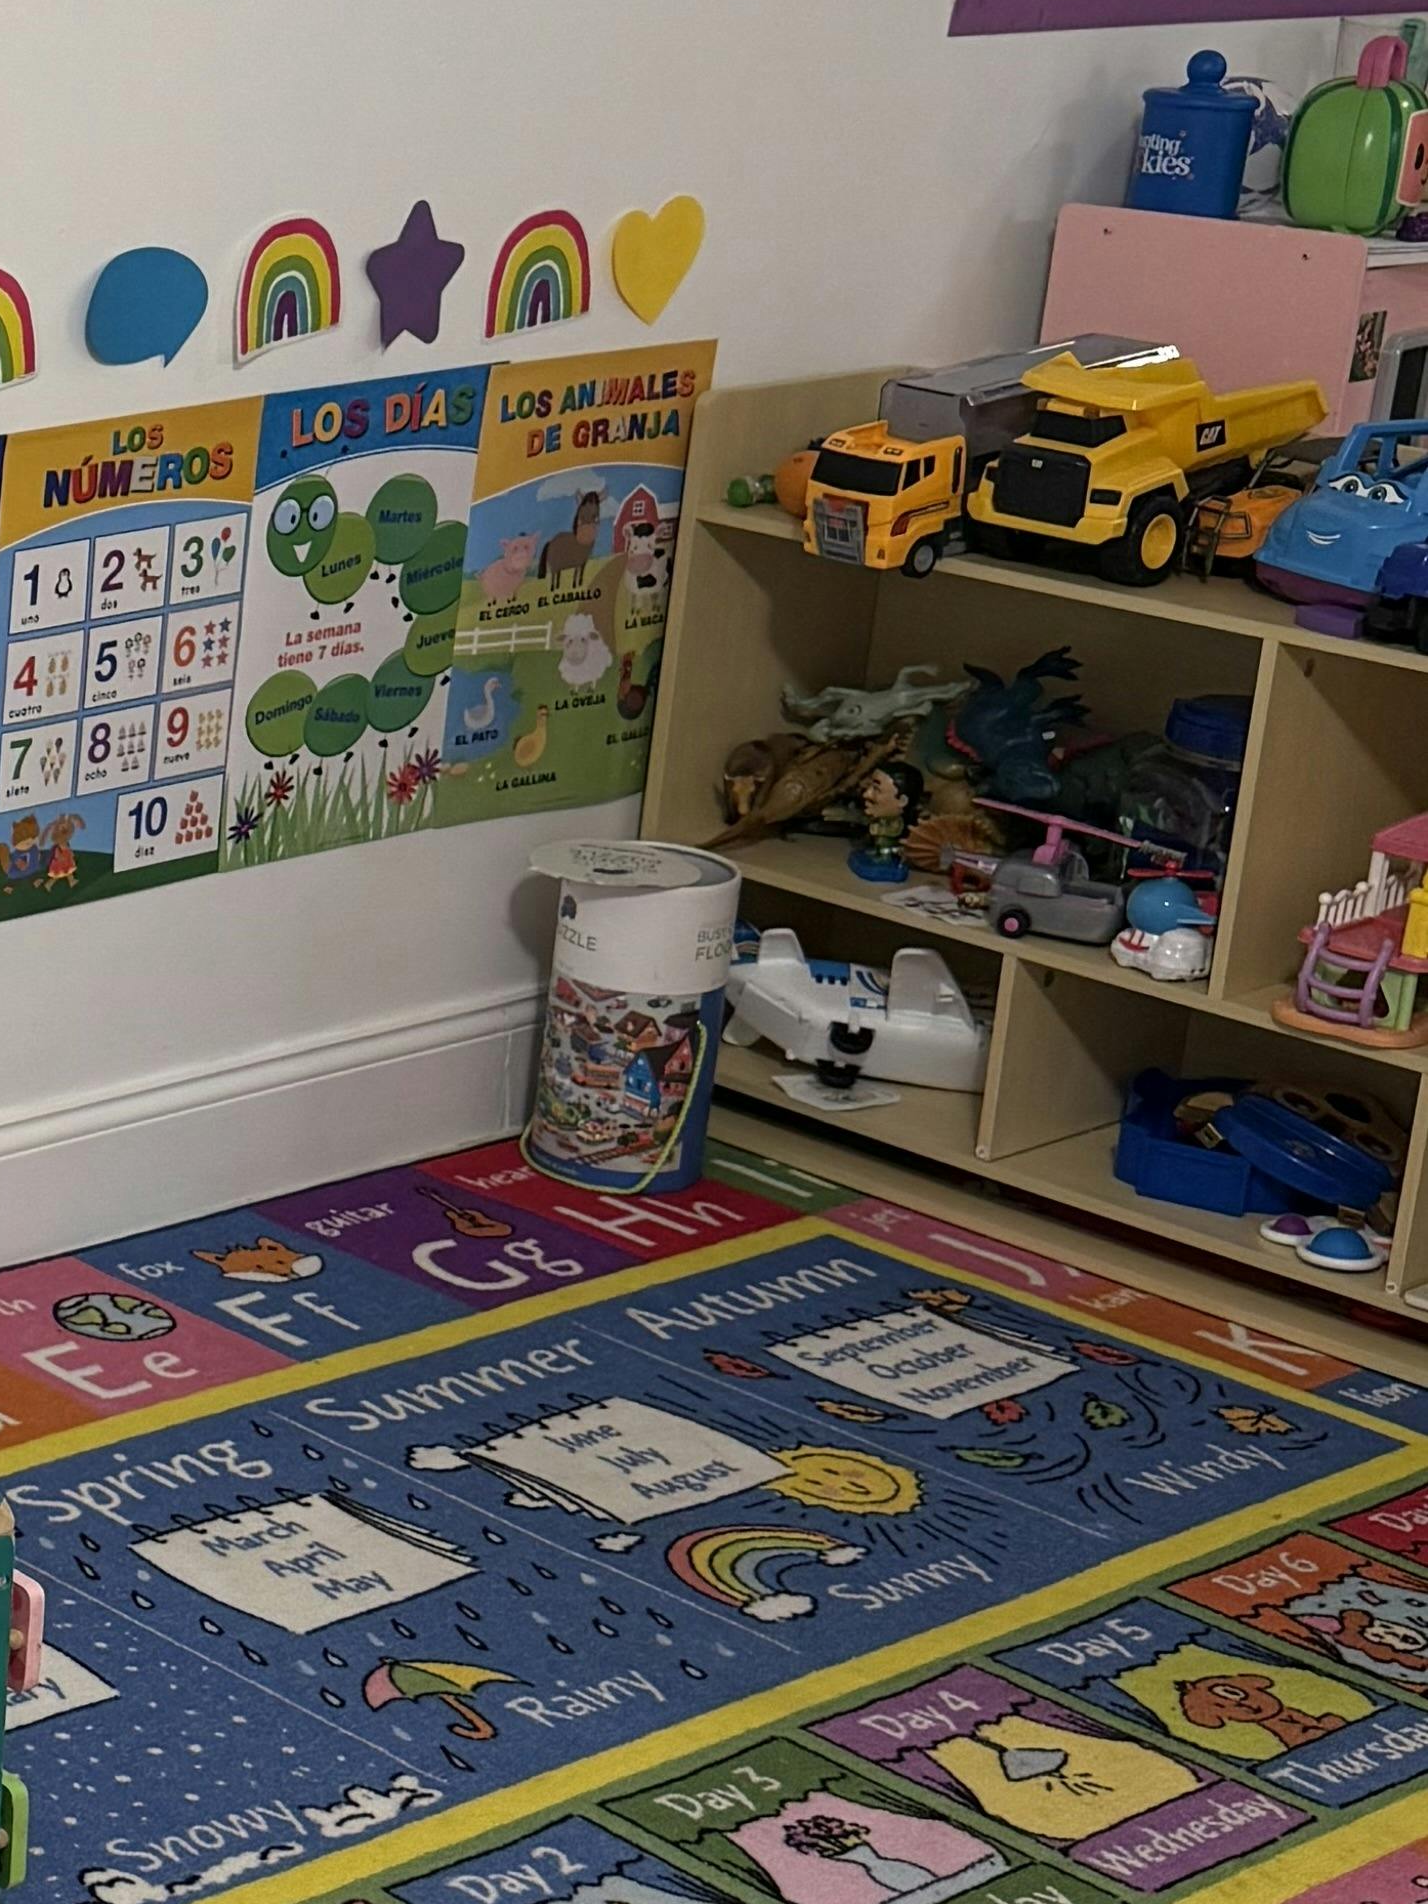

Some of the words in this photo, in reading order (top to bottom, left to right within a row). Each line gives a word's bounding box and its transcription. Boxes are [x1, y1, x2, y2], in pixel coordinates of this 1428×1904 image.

[292, 397, 370, 448] LOS
[385, 381, 475, 435] DÍAS
[500, 390, 553, 424] LOS
[559, 370, 697, 414] ANIMALES
[112, 424, 164, 456] LOS
[526, 424, 561, 457] DE
[572, 408, 681, 450] GRANJA
[1200, 425, 1222, 445] CAT
[43, 441, 234, 508] NÚMEROS
[379, 508, 422, 524] Martes
[100, 549, 125, 593] 2
[180, 535, 205, 578] 3
[321, 552, 362, 578] Lunes
[23, 564, 41, 607] 1
[553, 588, 602, 606] CABALLO
[285, 629, 306, 647] La
[308, 621, 362, 643] semana
[13, 654, 38, 696] 4
[94, 640, 119, 683] 5
[277, 649, 315, 668] tiene
[318, 646, 328, 661] 7
[254, 694, 313, 725] Domingo
[374, 682, 422, 700] Viernes
[572, 694, 606, 709] OVEJA
[314, 705, 361, 724] Sábado
[471, 729, 499, 744] PATO
[511, 772, 557, 788] GALLINA
[128, 795, 168, 840] 10
[558, 924, 597, 952] ZZLE
[305, 1199, 397, 1237] guitar
[117, 1257, 185, 1284] fox
[625, 1255, 880, 1342] Autumn
[796, 1317, 943, 1370] September
[866, 1341, 975, 1383] October
[304, 1336, 599, 1433] Summer
[897, 1353, 1037, 1405] November
[1338, 1381, 1419, 1409] lion
[543, 1421, 623, 1454] June
[595, 1444, 671, 1474] July
[629, 1458, 743, 1500] August
[1125, 1443, 1288, 1497] Windy
[4, 1439, 275, 1528] Spring
[201, 1518, 315, 1557] March
[264, 1543, 349, 1580] April
[827, 1552, 994, 1612] Sunny
[1212, 1565, 1302, 1597] Day
[1280, 1551, 1319, 1574] 6
[313, 1568, 394, 1602] May
[1038, 1634, 1134, 1666] Day
[1117, 1618, 1153, 1641] 5
[503, 1665, 667, 1728] Rainy
[859, 1704, 956, 1741] Day
[939, 1690, 982, 1715] 4
[1266, 1716, 1428, 1794] Thursda
[654, 1782, 755, 1820] Day
[733, 1765, 781, 1792] 3
[104, 1799, 307, 1875] Snowy
[1087, 1792, 1289, 1877] Wednesday
[448, 1865, 553, 1904] Day
[531, 1846, 587, 1875] 2
